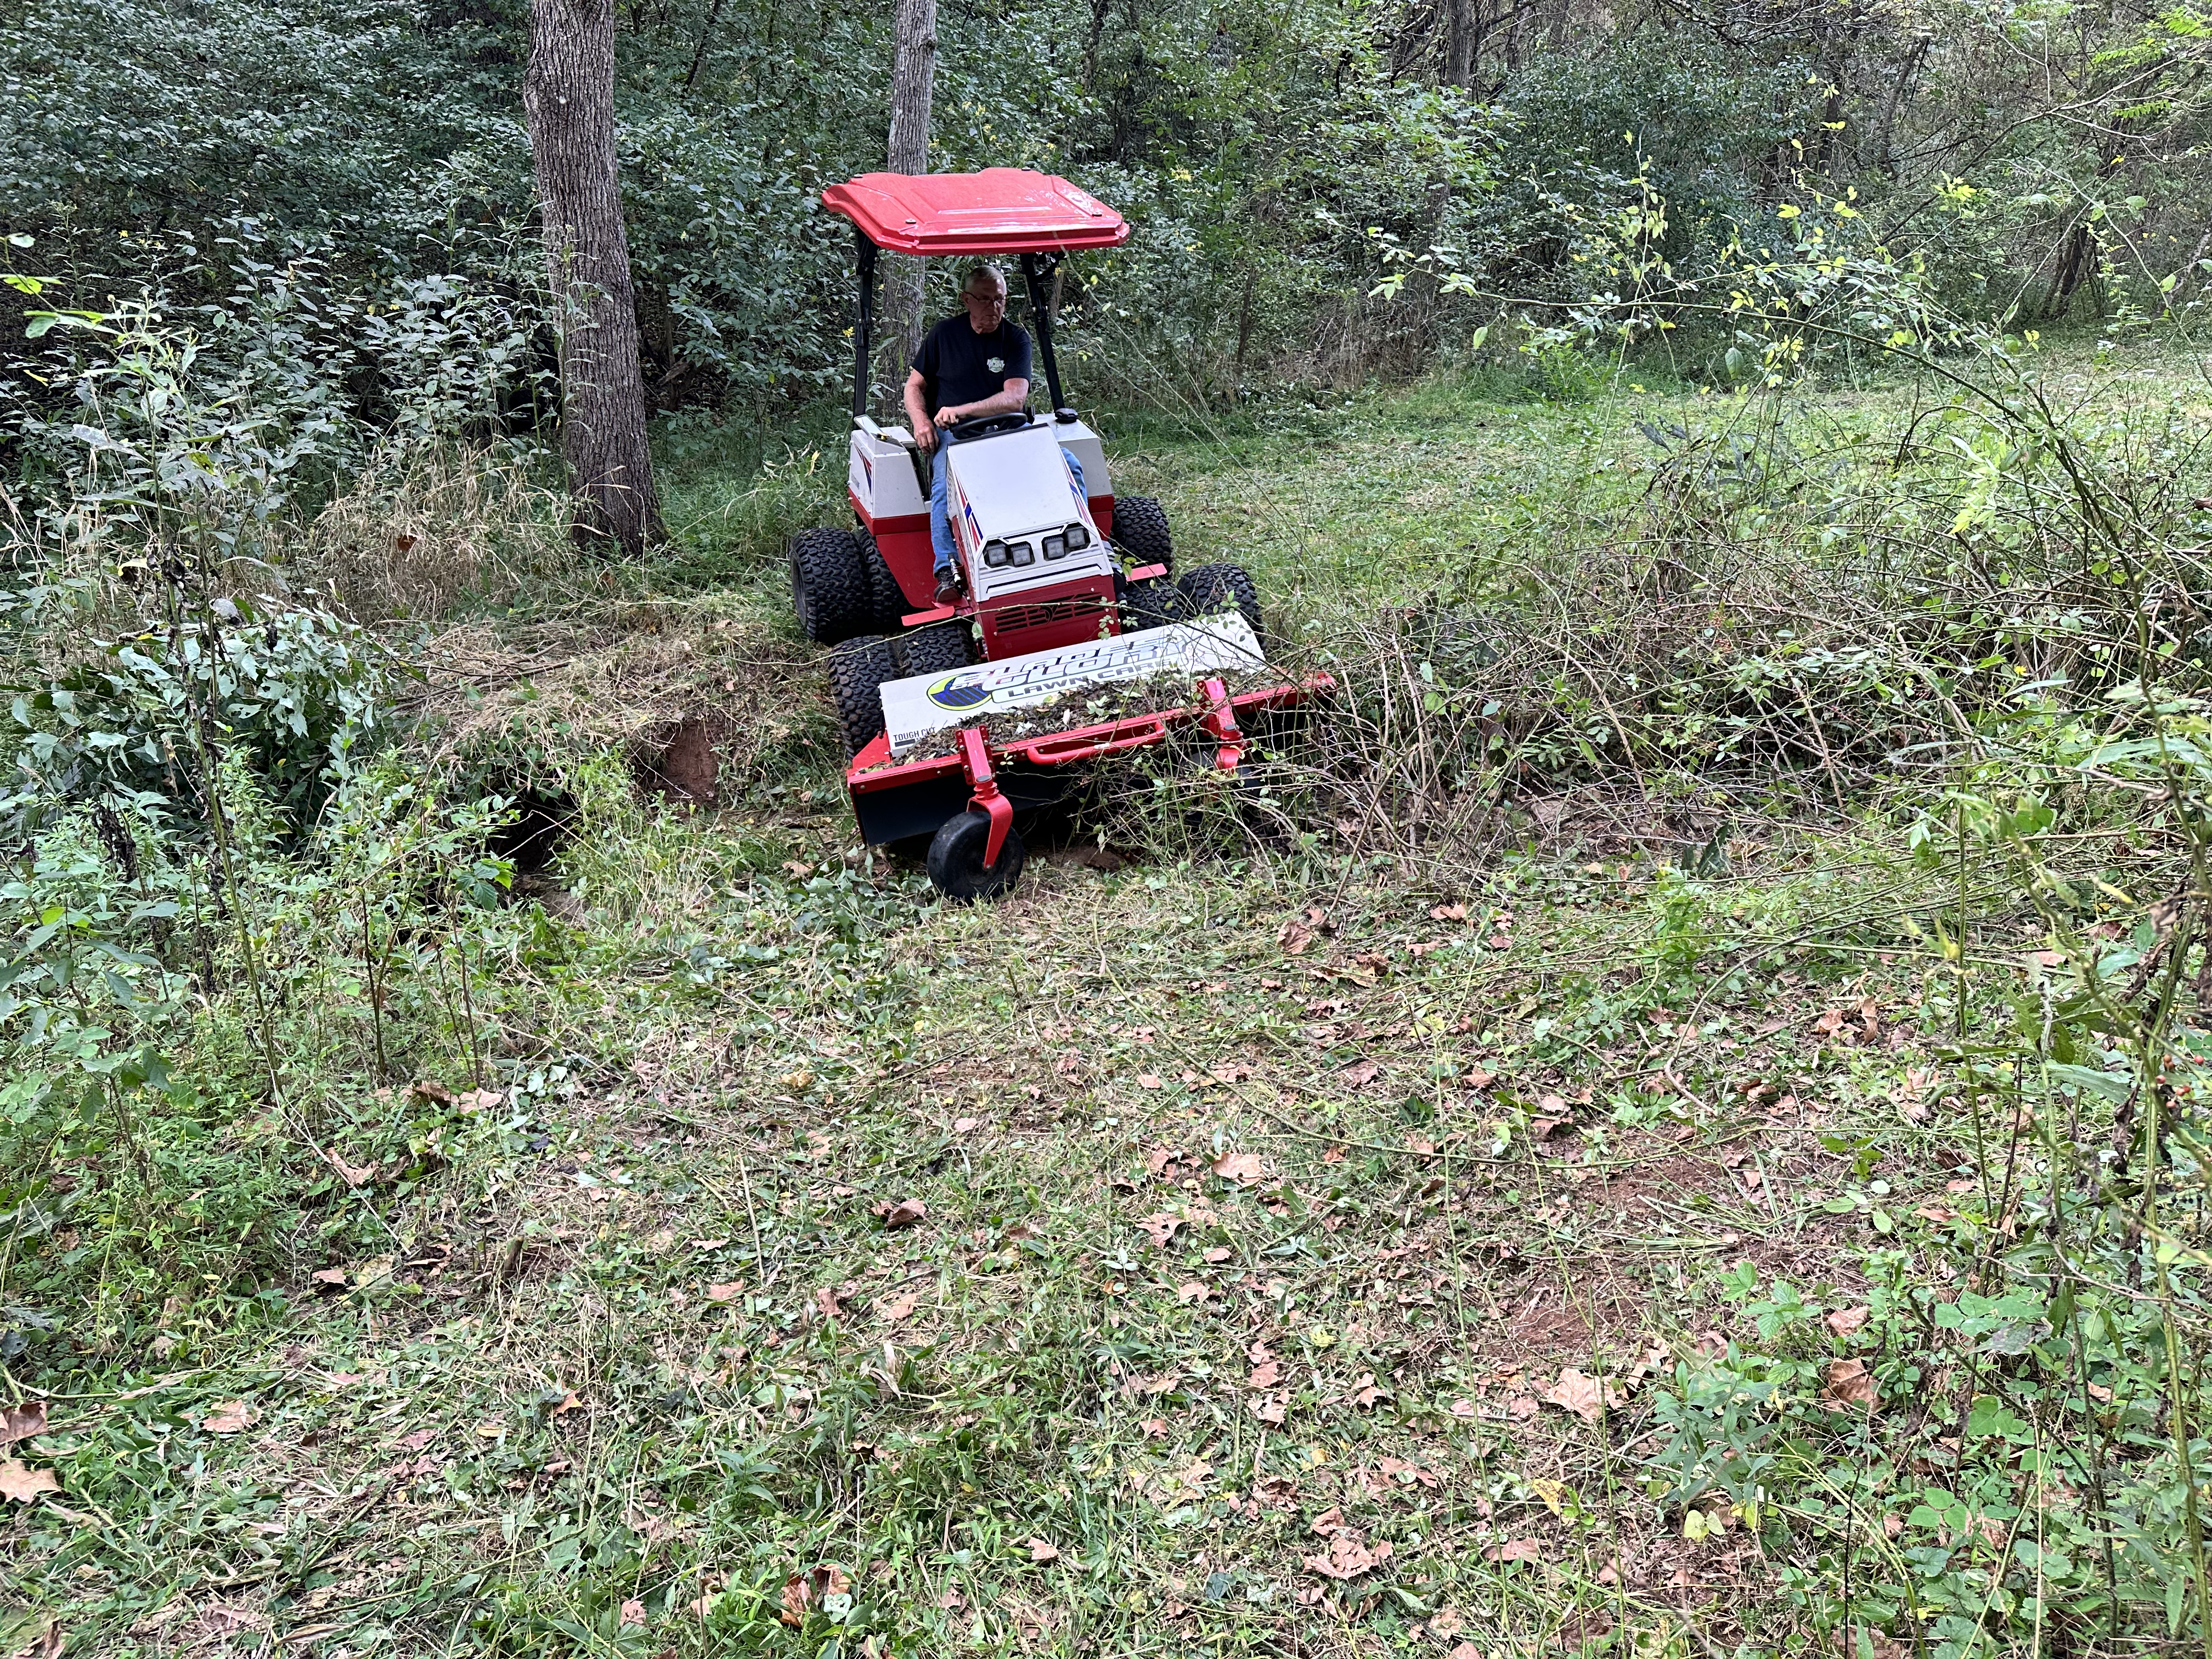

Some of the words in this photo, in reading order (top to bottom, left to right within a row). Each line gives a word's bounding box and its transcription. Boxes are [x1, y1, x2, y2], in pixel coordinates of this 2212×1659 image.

[952, 634, 1178, 686] BLADES
[1008, 675, 1090, 697] LAWN
[1098, 658, 1171, 679] CARE
[893, 730, 919, 742] TOUGH
